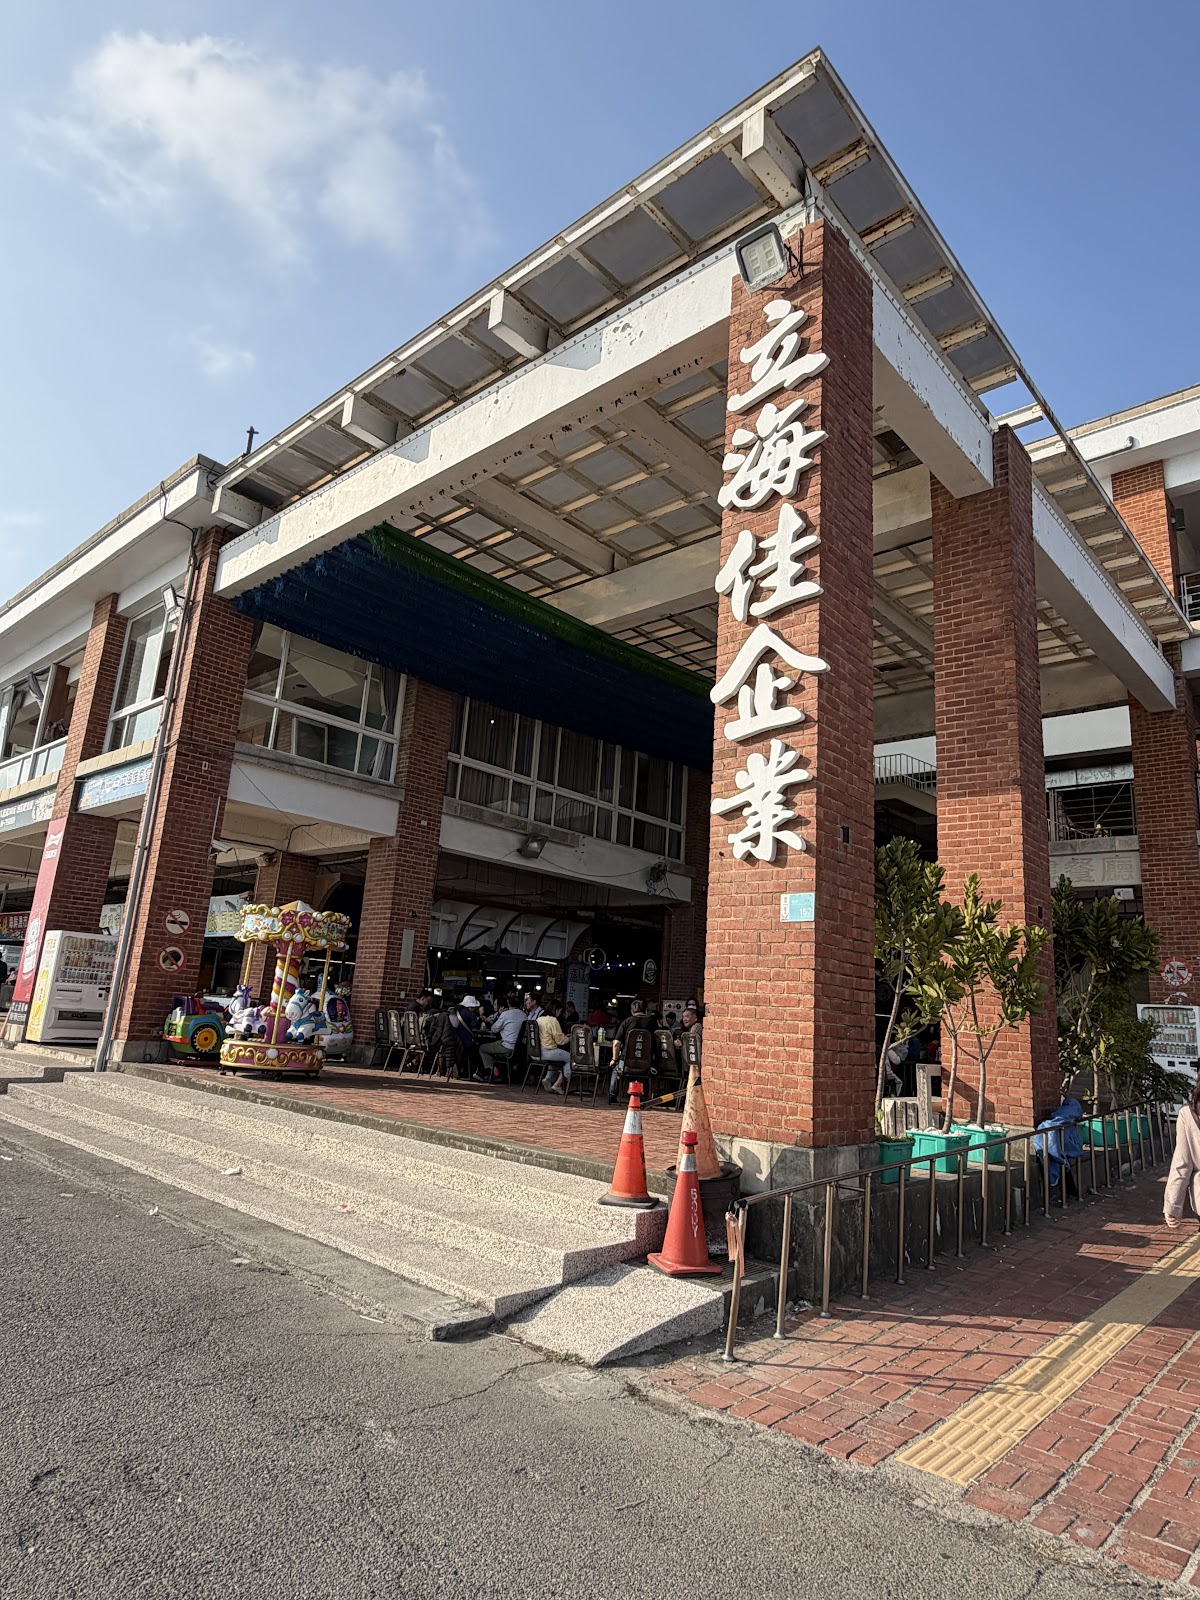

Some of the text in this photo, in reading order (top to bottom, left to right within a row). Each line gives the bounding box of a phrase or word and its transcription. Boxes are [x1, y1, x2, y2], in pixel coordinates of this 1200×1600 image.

[710, 299, 831, 862] 立海佳企業
